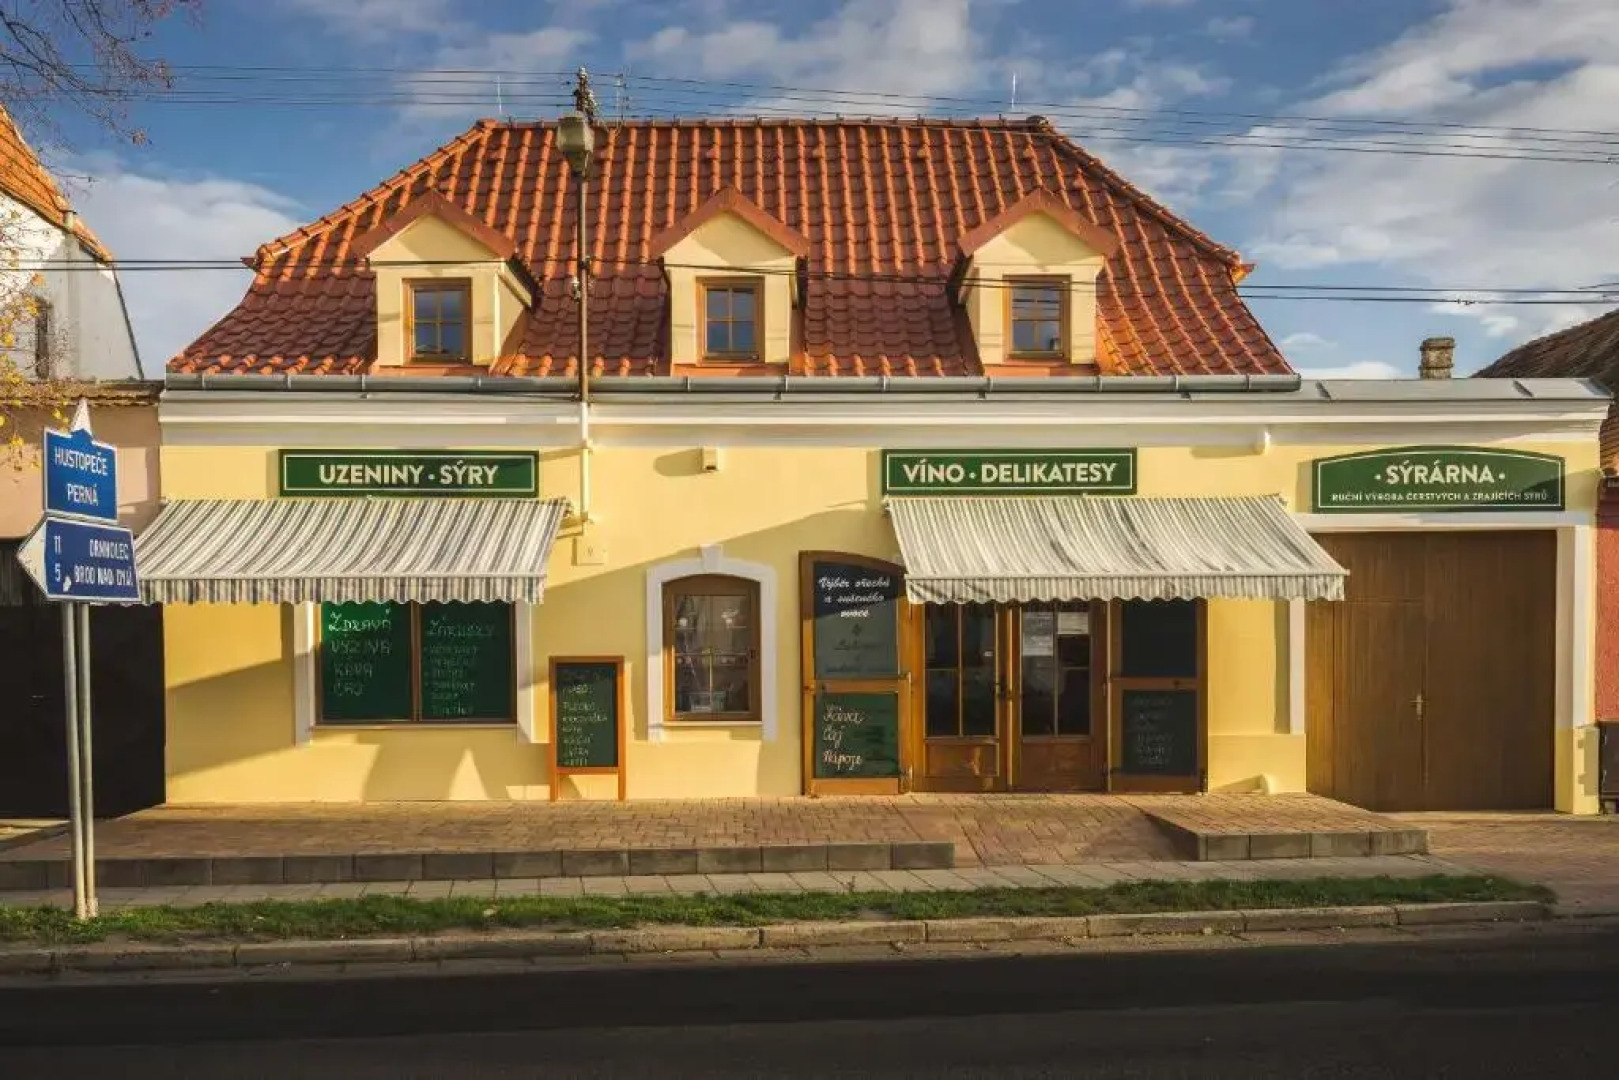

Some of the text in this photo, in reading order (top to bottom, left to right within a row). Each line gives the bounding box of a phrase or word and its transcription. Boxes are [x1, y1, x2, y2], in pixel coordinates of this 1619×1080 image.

[54, 447, 108, 476] HUSTOPEČE
[319, 459, 499, 485] UZENINY SÝRY
[903, 458, 1118, 483] VÍNO DELIKATESY
[1386, 460, 1495, 485] SÝRÁRNA
[67, 483, 98, 506] PERNÁ
[1332, 490, 1547, 502] RUČNÍ VÝROBA ČERSTVÝCH A ZRAJÍCÍCH SÝRŮ
